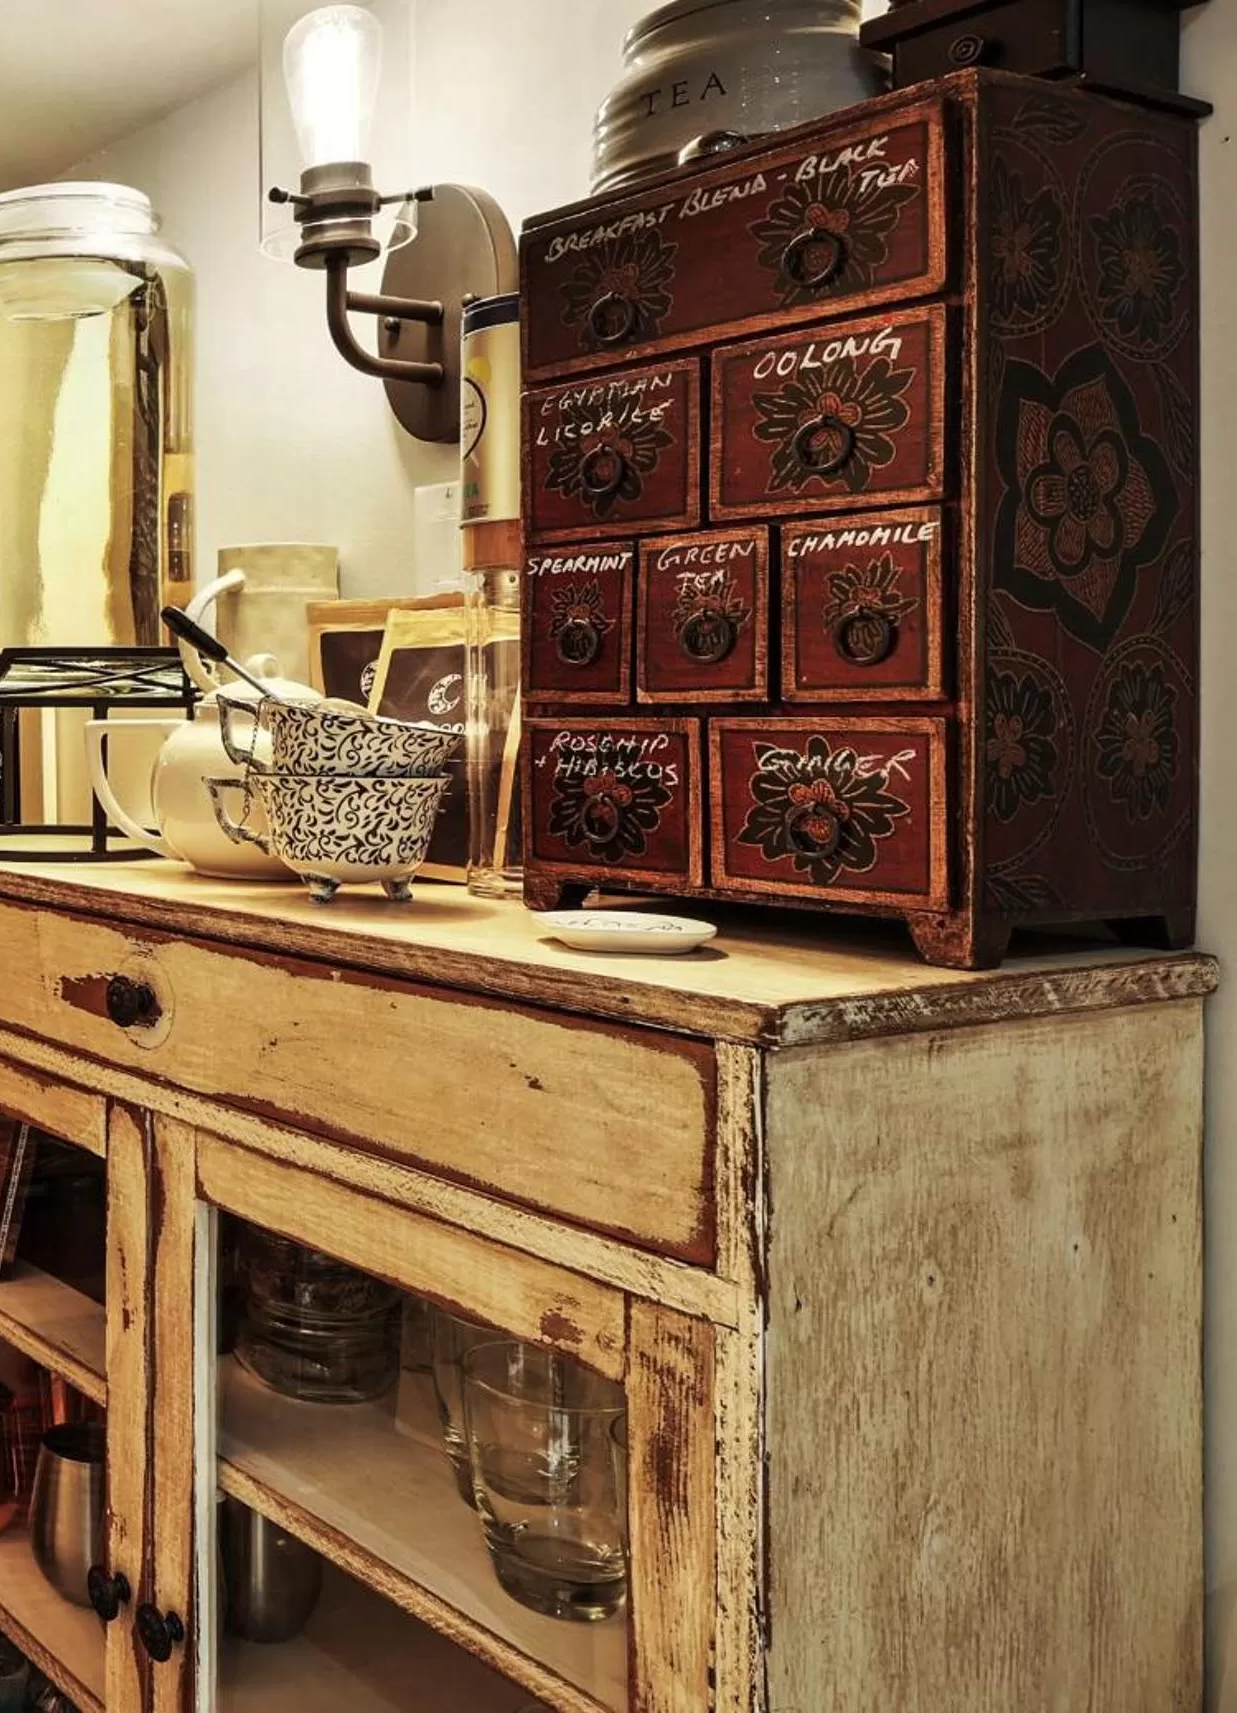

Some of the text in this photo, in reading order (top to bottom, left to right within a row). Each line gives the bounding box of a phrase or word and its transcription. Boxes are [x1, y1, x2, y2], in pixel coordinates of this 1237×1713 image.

[640, 71, 727, 117] TEA
[544, 203, 675, 262] BREAKFAST
[795, 136, 889, 184] BLACK
[753, 327, 903, 379] OOLONG
[657, 540, 755, 573] GREEN
[787, 522, 941, 558] CHAMOMILE
[527, 551, 634, 576] SPEARMINT
[548, 730, 670, 754] ROSEHIP
[554, 756, 679, 786] HIBISCUS
[758, 748, 917, 782] GINGER
